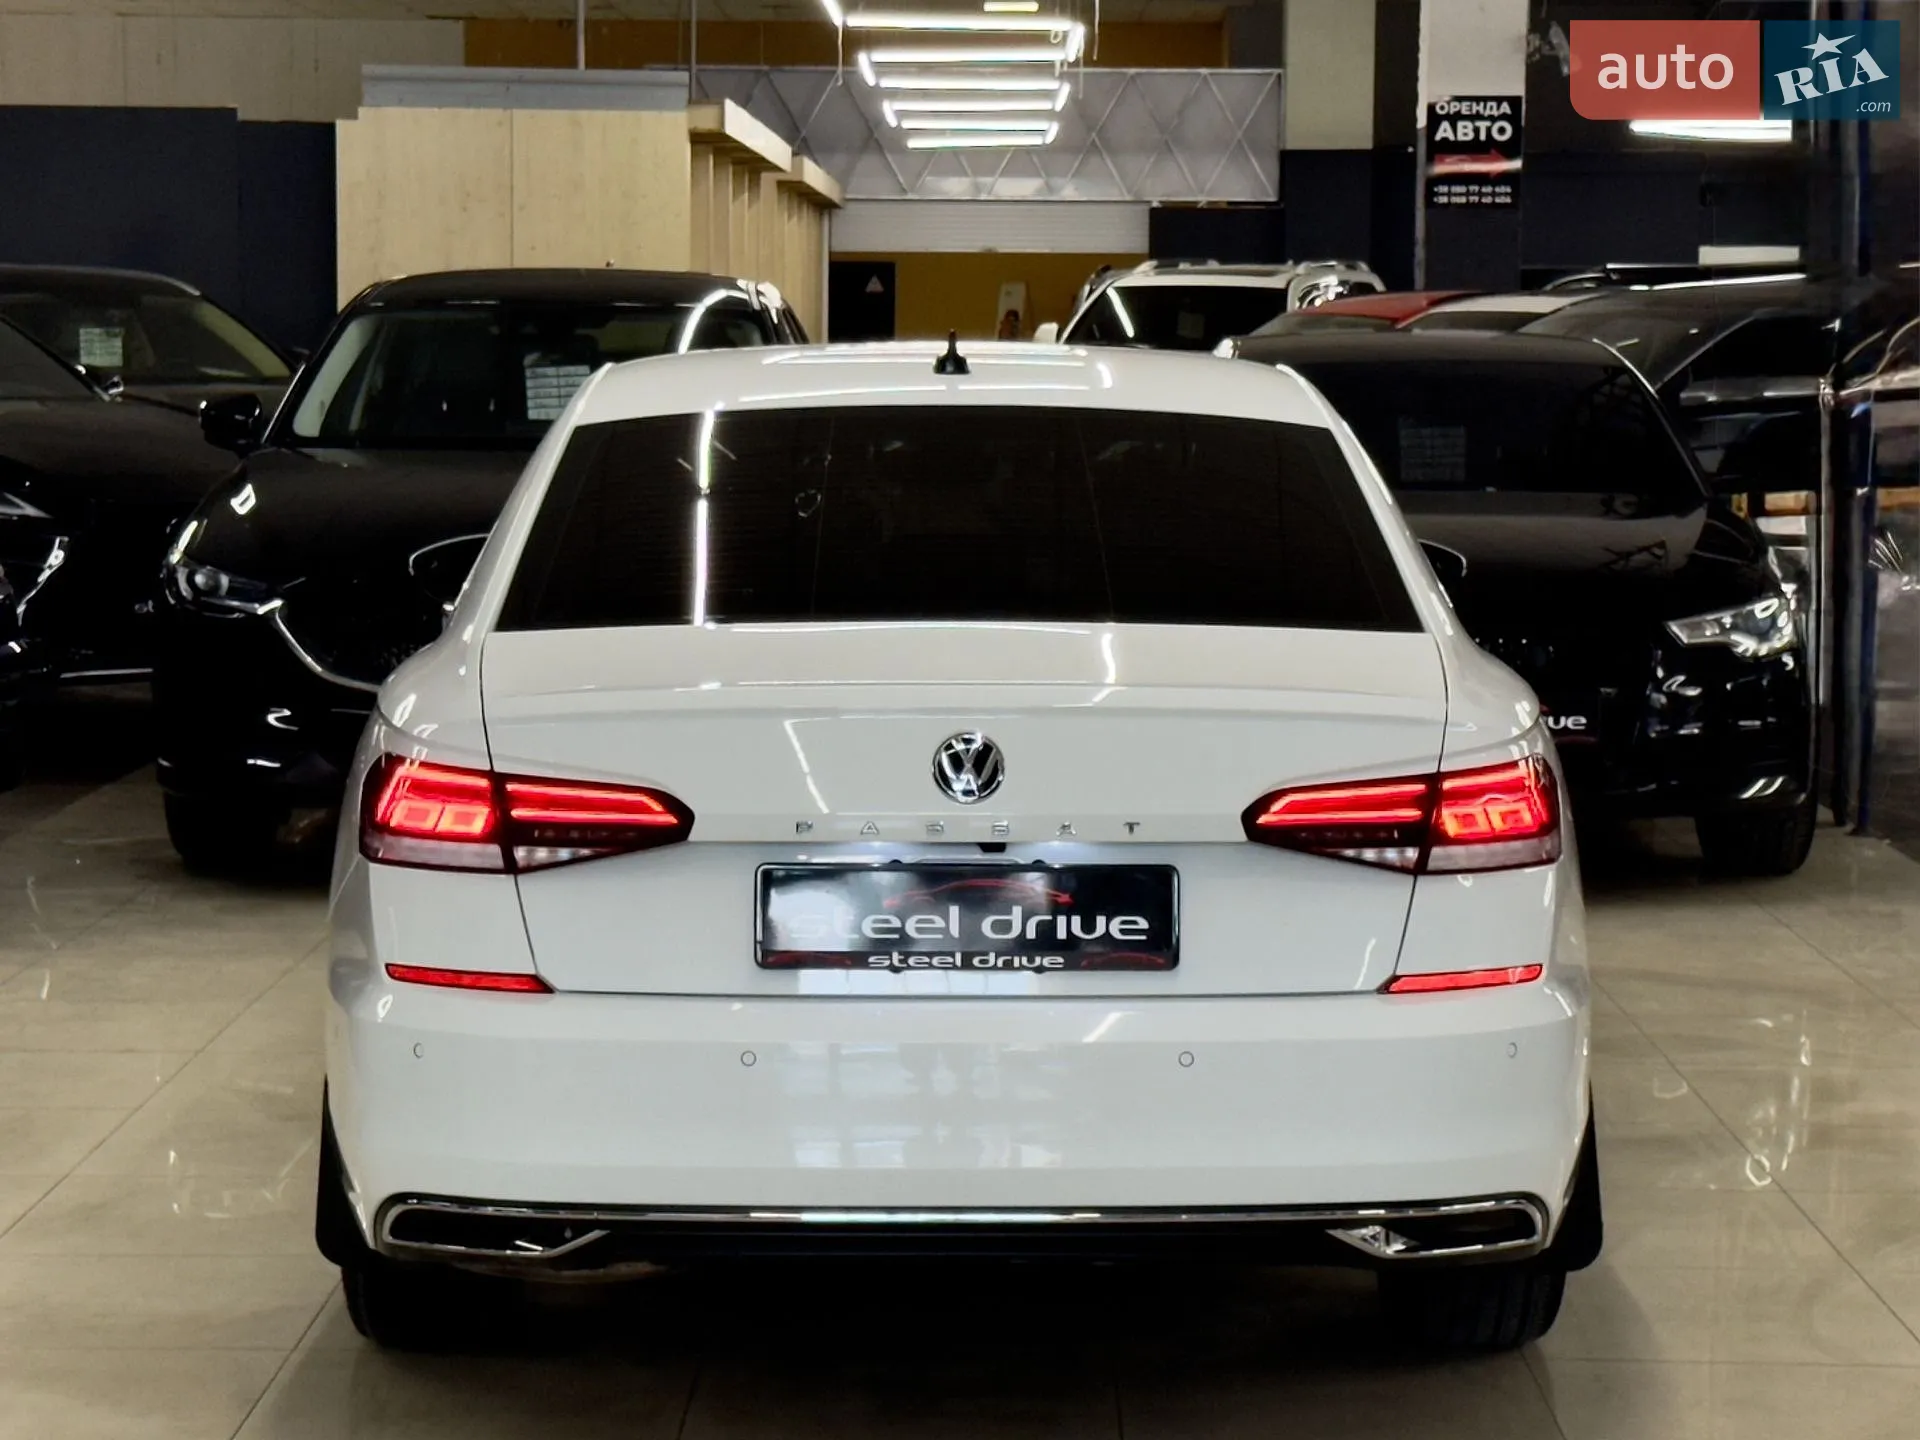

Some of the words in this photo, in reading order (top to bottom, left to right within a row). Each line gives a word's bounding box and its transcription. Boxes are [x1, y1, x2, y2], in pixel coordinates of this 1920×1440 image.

[1435, 101, 1512, 117] ОРЕНДА
[1434, 120, 1513, 142] АВТО
[796, 820, 1141, 836] PASSAT
[790, 905, 960, 939] steel
[981, 905, 1150, 940] drive
[867, 951, 962, 969] steel
[972, 951, 1065, 969] drive
